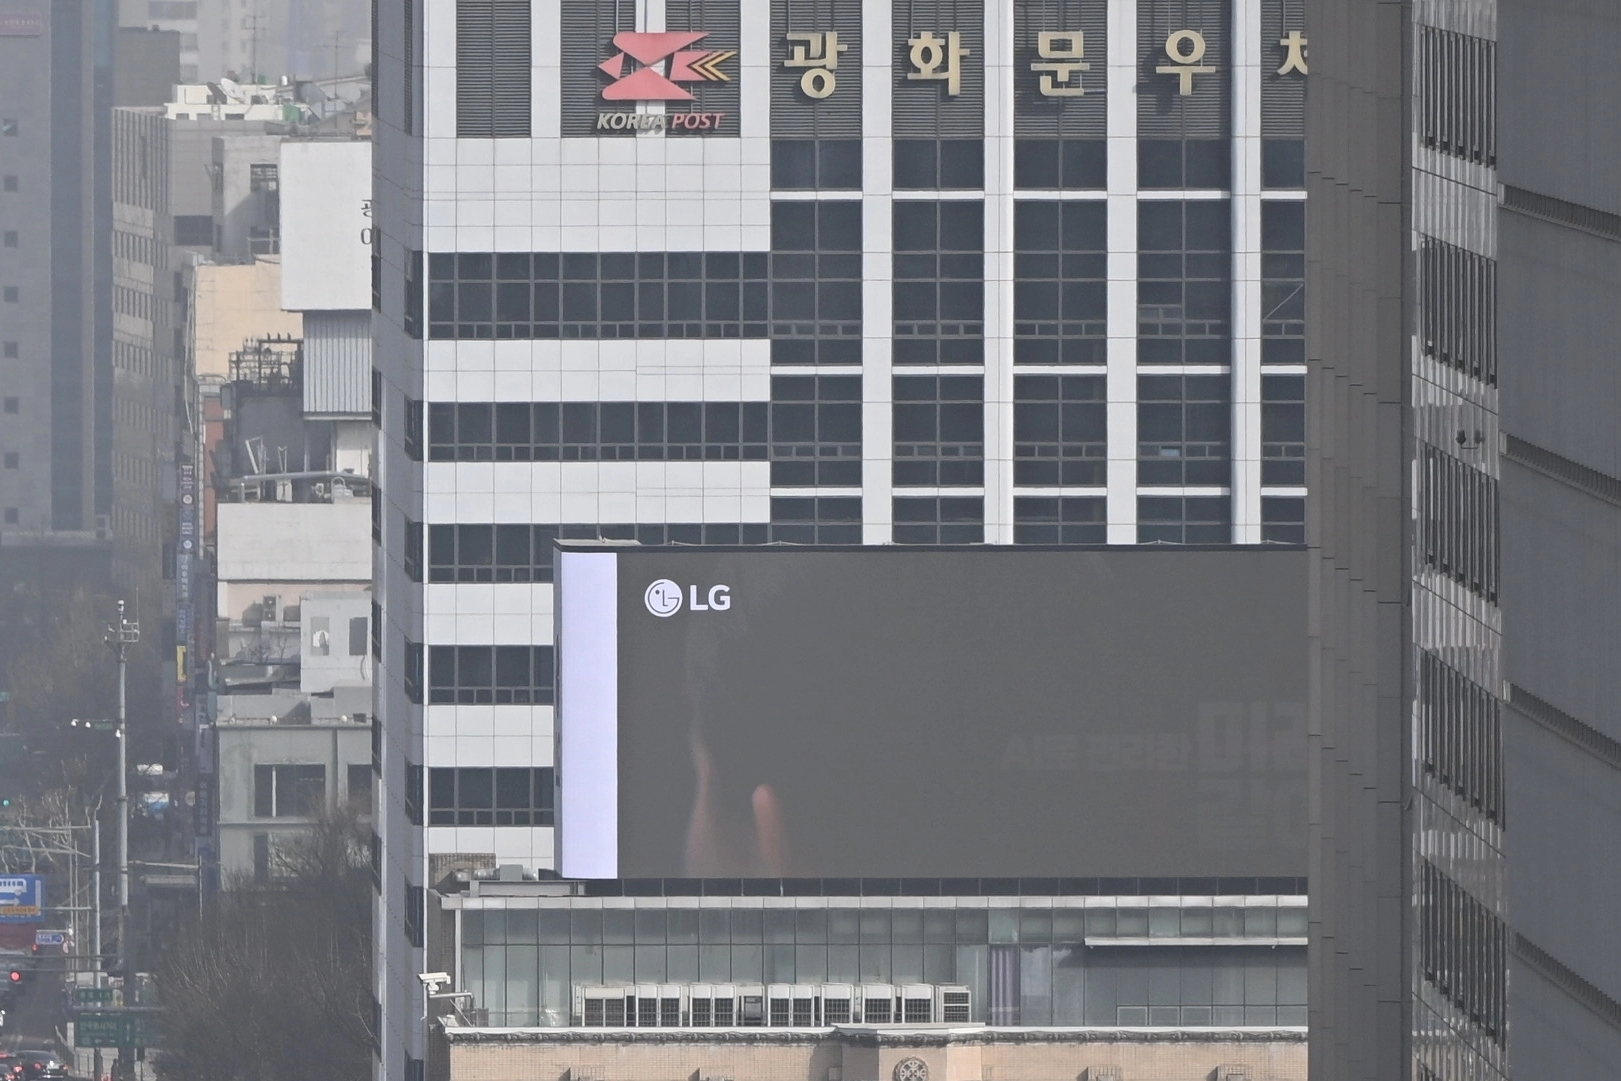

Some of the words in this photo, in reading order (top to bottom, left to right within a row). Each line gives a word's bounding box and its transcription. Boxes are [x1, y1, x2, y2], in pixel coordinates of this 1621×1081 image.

[597, 113, 665, 130] KOREA
[671, 113, 725, 130] POST
[689, 584, 731, 611] LG
